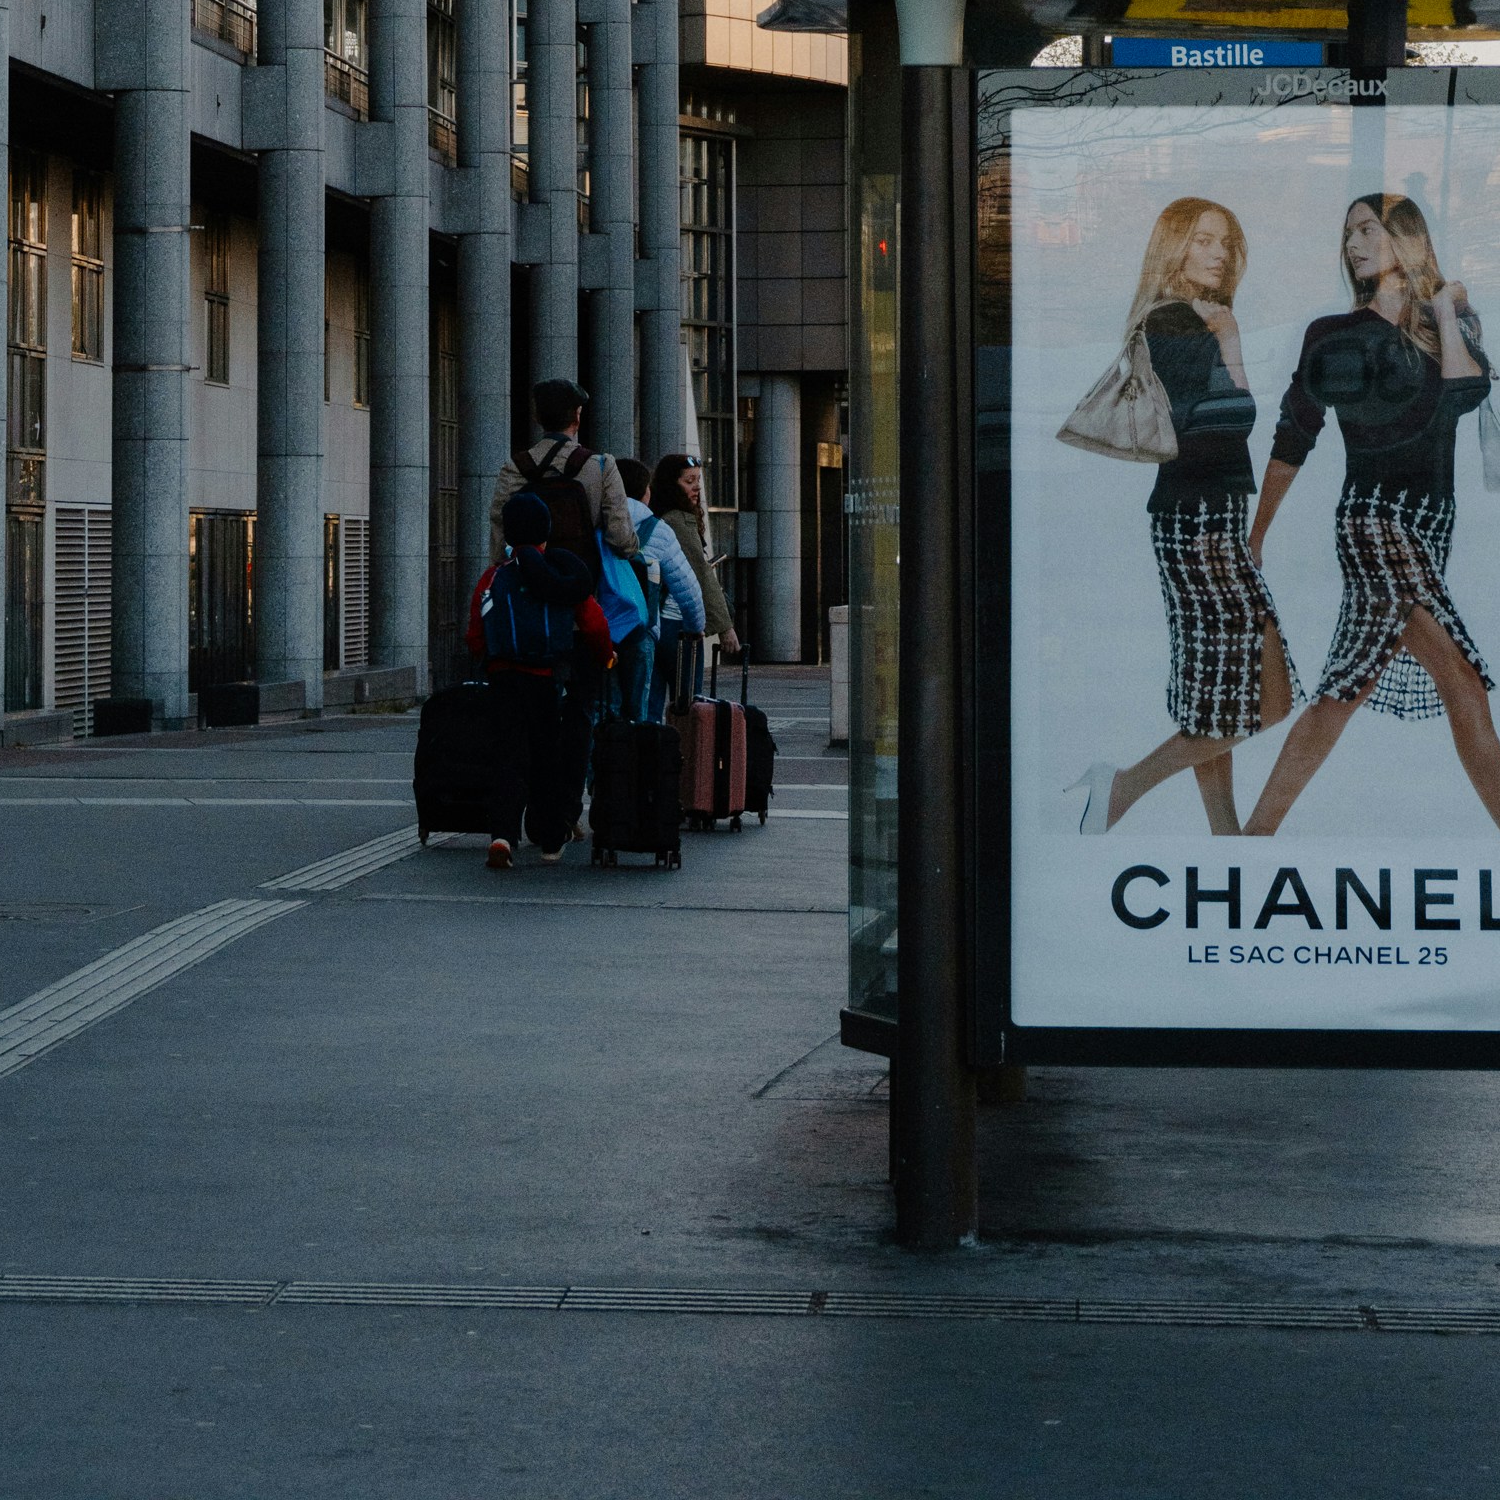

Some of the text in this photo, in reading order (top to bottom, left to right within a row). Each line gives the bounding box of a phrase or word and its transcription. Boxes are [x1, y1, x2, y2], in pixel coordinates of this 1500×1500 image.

[1171, 44, 1264, 67] Bastille
[1257, 73, 1389, 96] JCDecaux
[1188, 945, 1448, 966] LE SAC CHANEL 25
